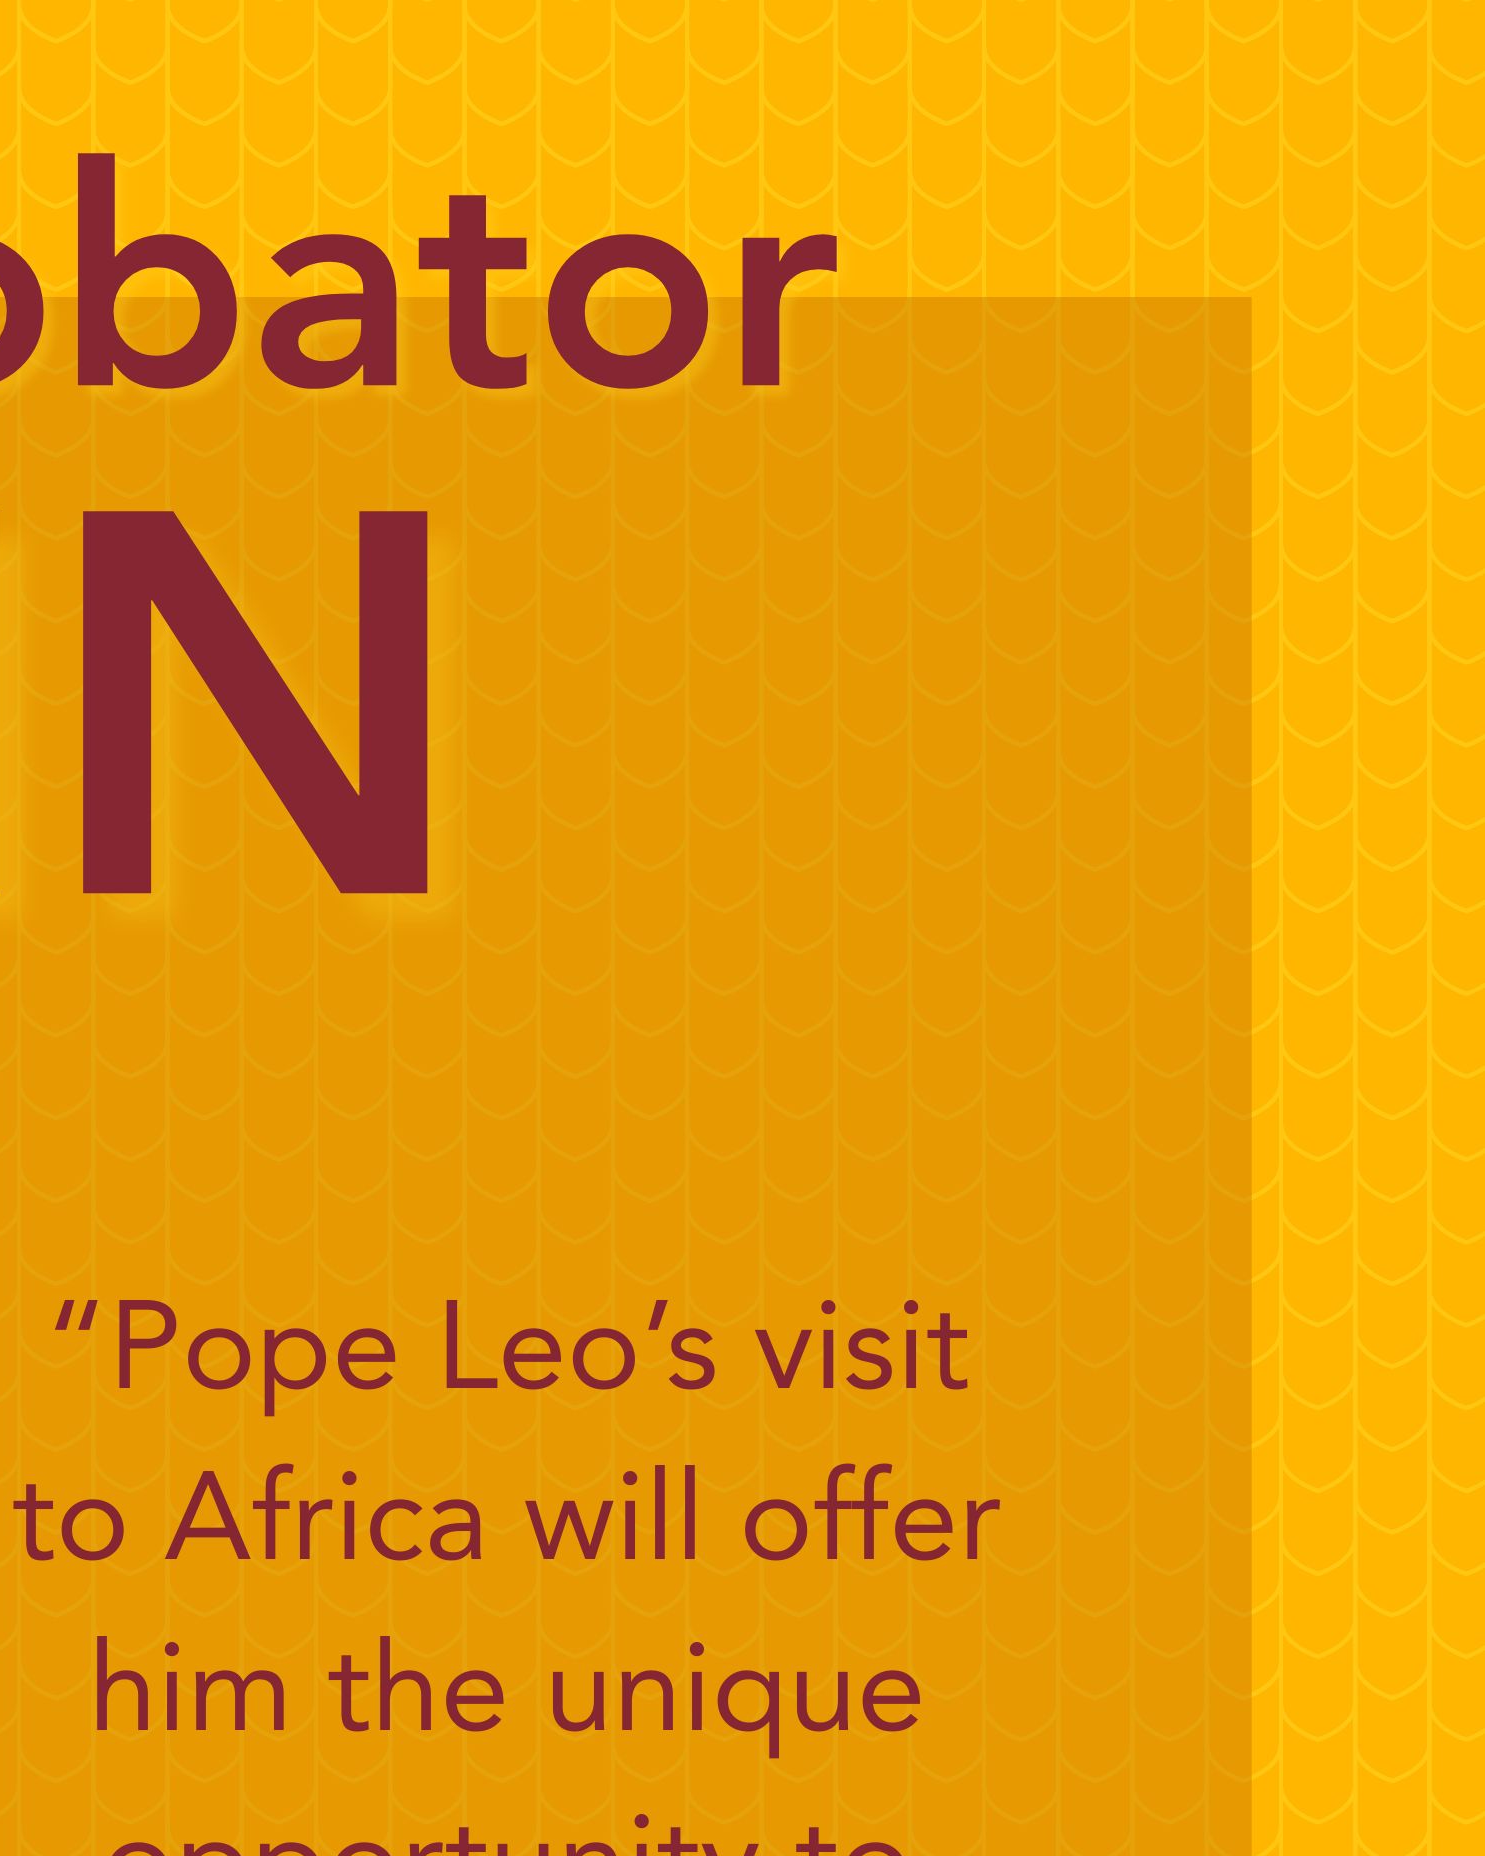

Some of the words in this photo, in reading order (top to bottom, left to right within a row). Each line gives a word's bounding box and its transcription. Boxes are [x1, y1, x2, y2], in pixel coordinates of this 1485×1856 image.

[55, 1300, 395, 1416] “Pope
[447, 1300, 715, 1389] Leo’s
[755, 1300, 967, 1390] visit
[13, 1484, 124, 1561] to
[165, 1463, 481, 1560] Africa
[525, 1465, 695, 1559] will
[745, 1464, 1000, 1560] offer
[97, 1636, 284, 1730] him
[329, 1636, 504, 1732] the
[553, 1642, 920, 1758] unique
